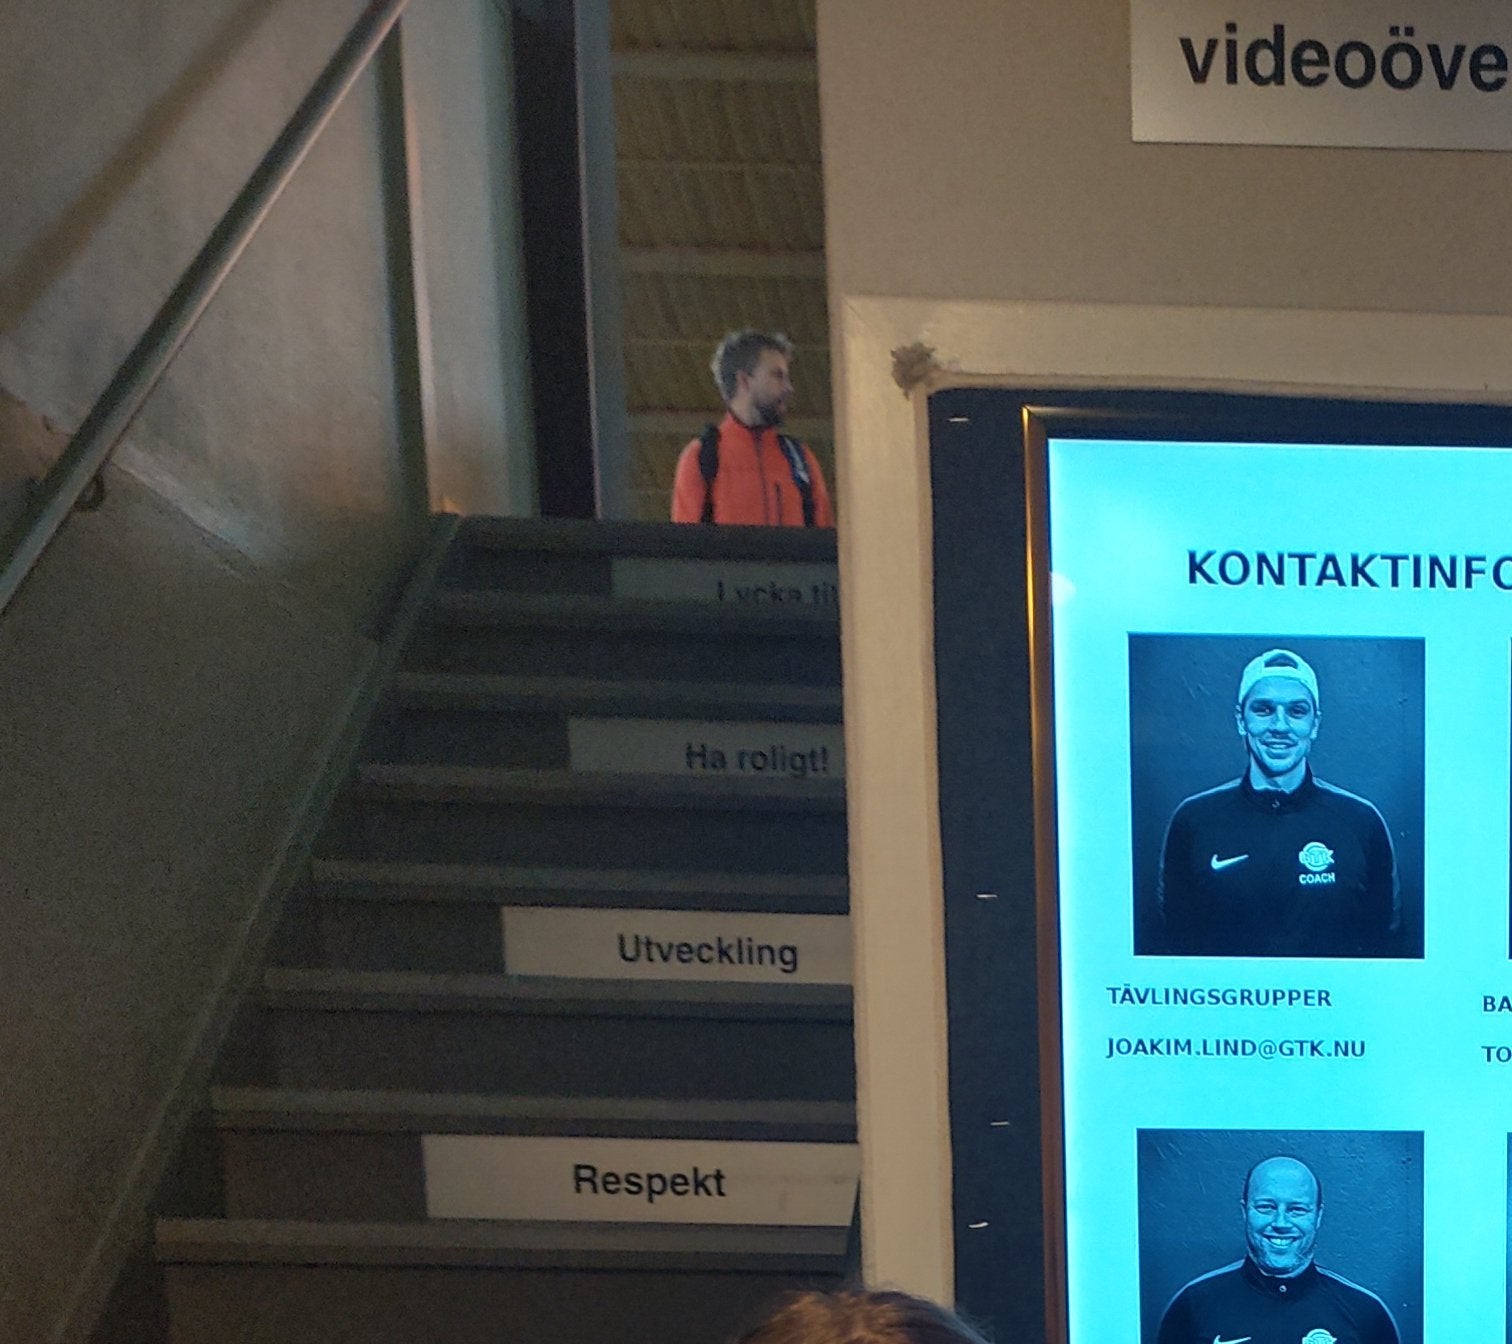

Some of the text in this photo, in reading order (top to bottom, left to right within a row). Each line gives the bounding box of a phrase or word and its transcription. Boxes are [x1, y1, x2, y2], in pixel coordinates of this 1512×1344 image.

[685, 743, 829, 778] Ha roligt!
[1299, 872, 1336, 885] COACH
[618, 933, 798, 973] Utveckling
[1106, 984, 1331, 1006] TÄVLINGSGRUPPER
[1106, 1038, 1365, 1059] JOAKIM.LIND@GTK.NU
[574, 1164, 726, 1201] Respekt
